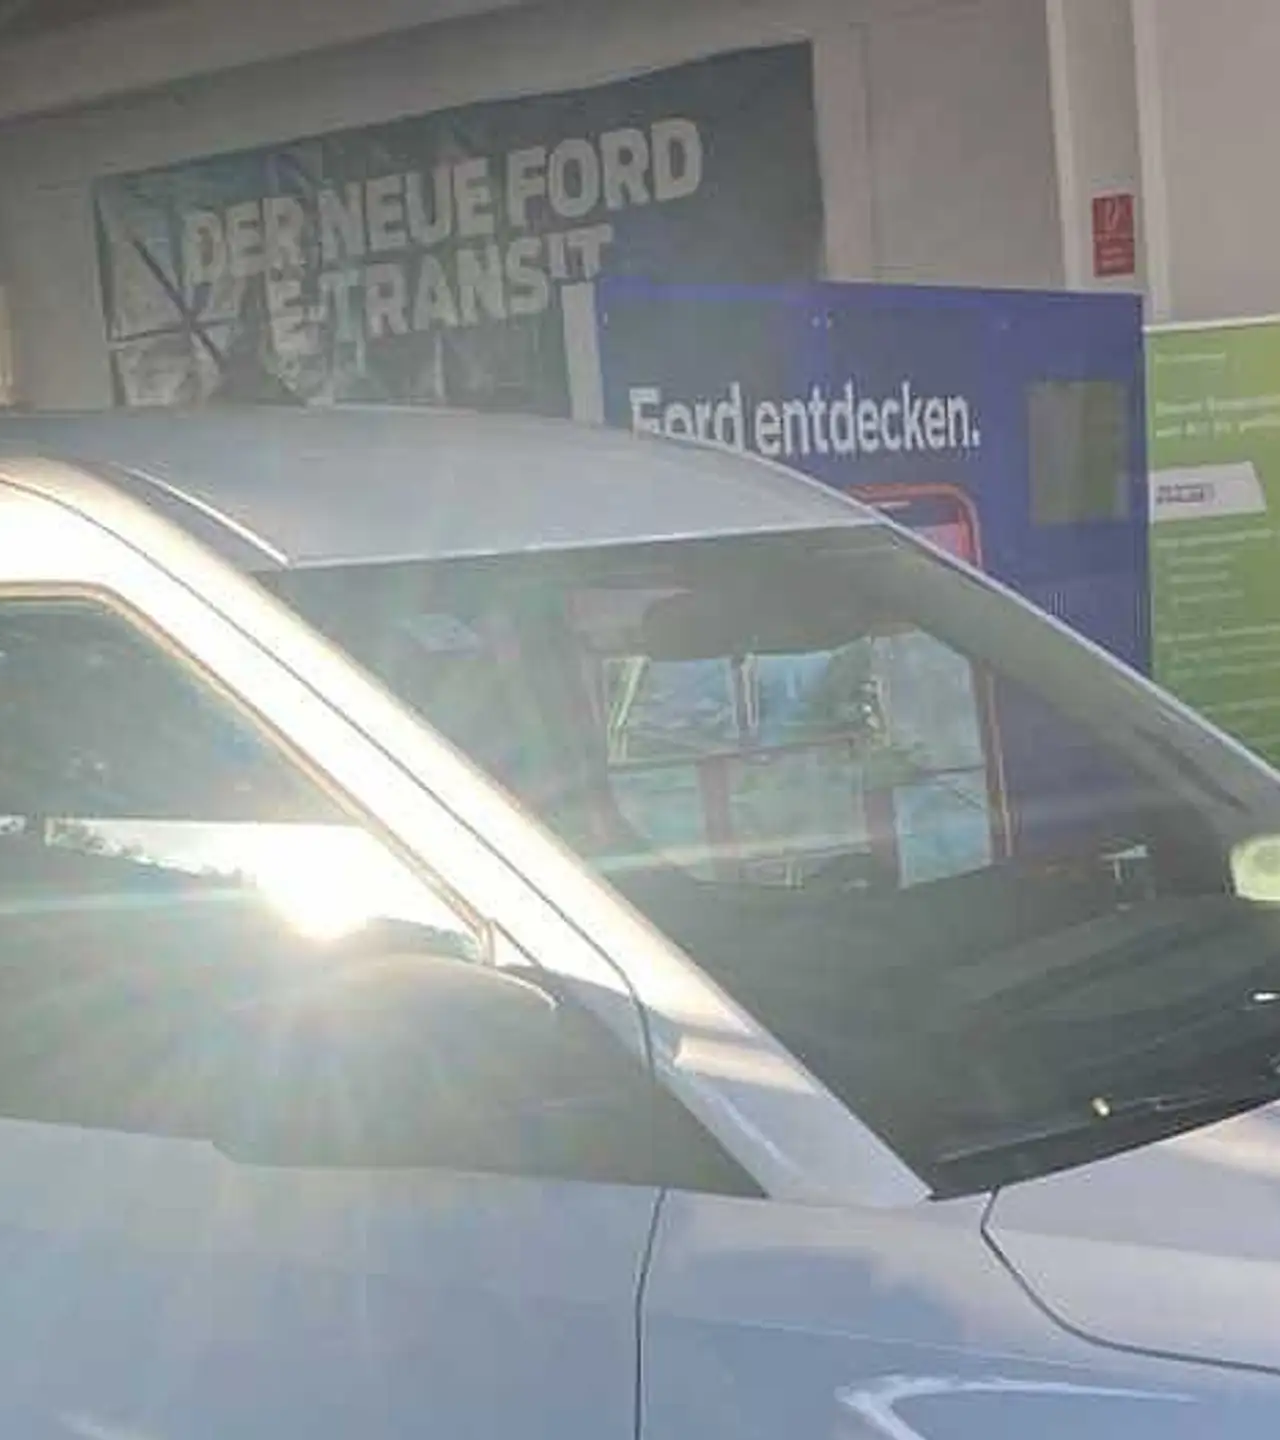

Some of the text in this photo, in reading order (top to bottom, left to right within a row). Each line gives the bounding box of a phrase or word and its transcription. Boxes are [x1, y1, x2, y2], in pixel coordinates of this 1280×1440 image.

[181, 117, 704, 288] DER NEUE FORD
[629, 379, 982, 456] Ford entdecken.
